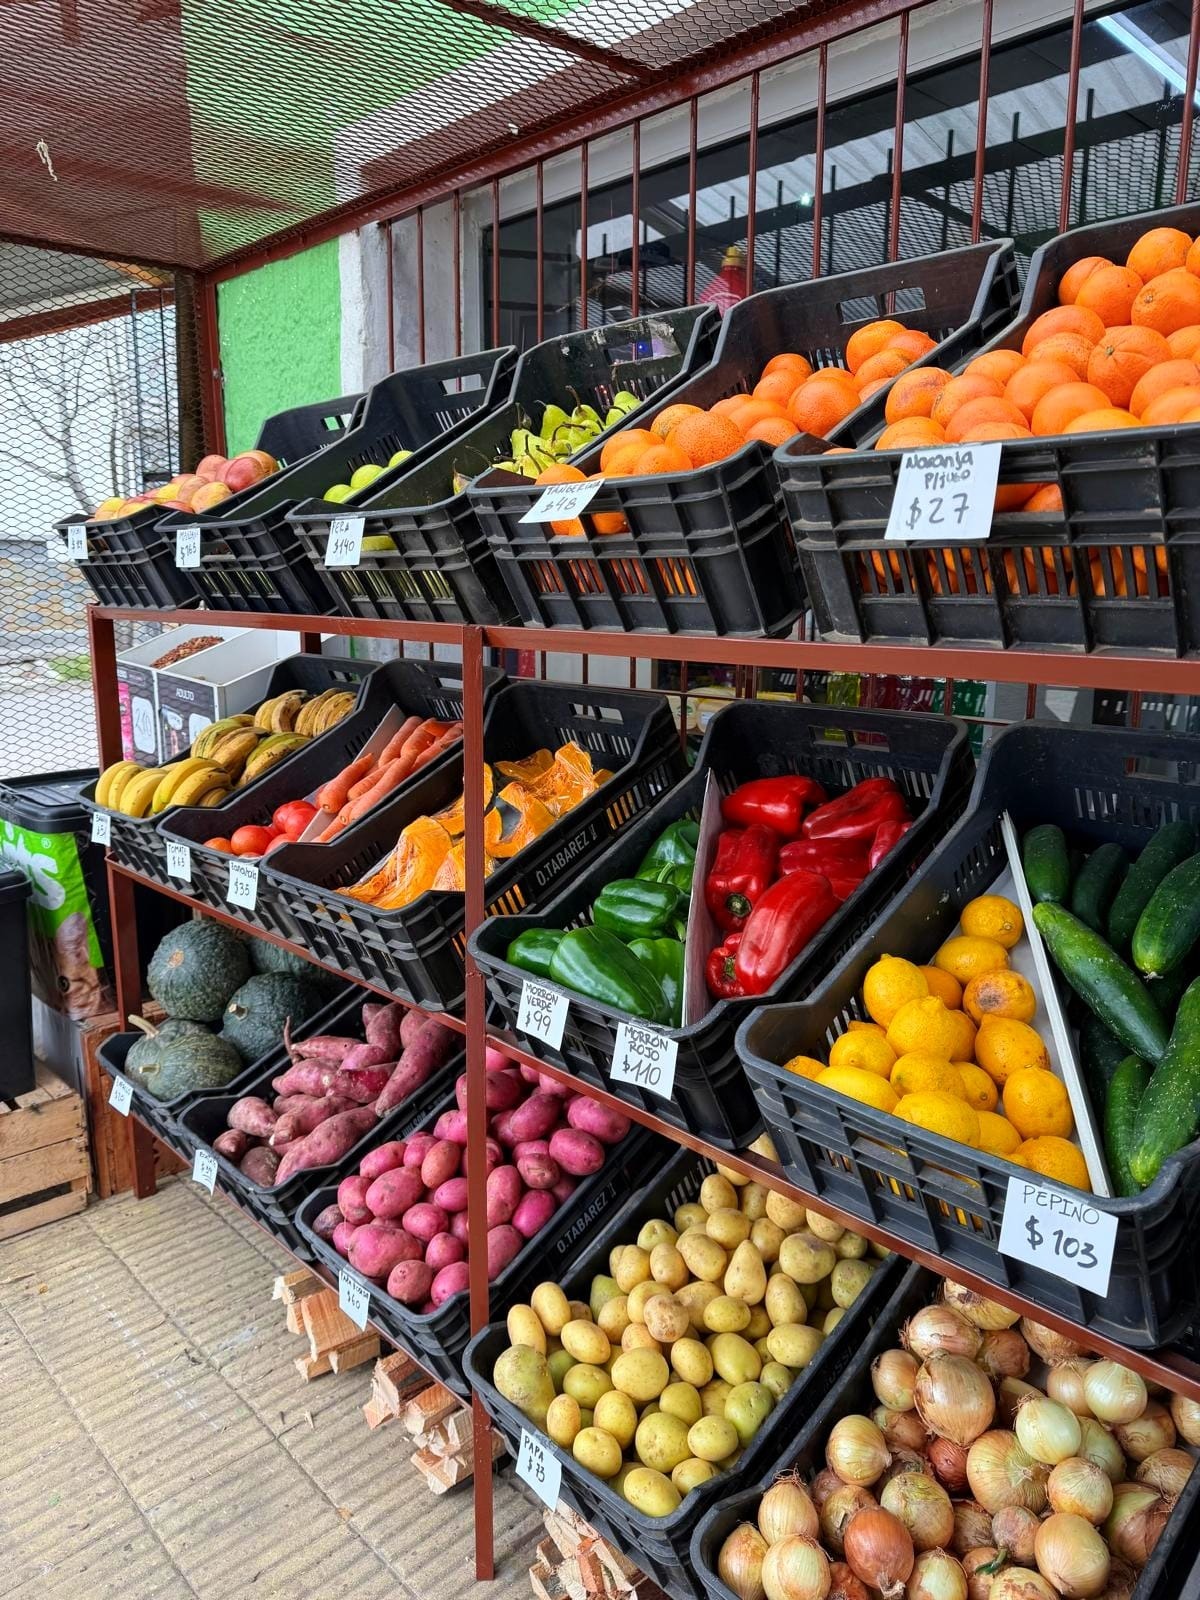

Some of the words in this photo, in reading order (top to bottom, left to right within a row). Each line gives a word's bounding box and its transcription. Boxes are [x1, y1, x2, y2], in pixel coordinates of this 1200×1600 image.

[234, 877, 250, 896] $35
[526, 994, 553, 1013] VERDE
[524, 1010, 552, 1036] $99
[628, 1040, 660, 1062] ROJO
[622, 1053, 662, 1086] $110
[1023, 1184, 1100, 1225] PEPINO
[524, 1435, 544, 1463] PAPA
